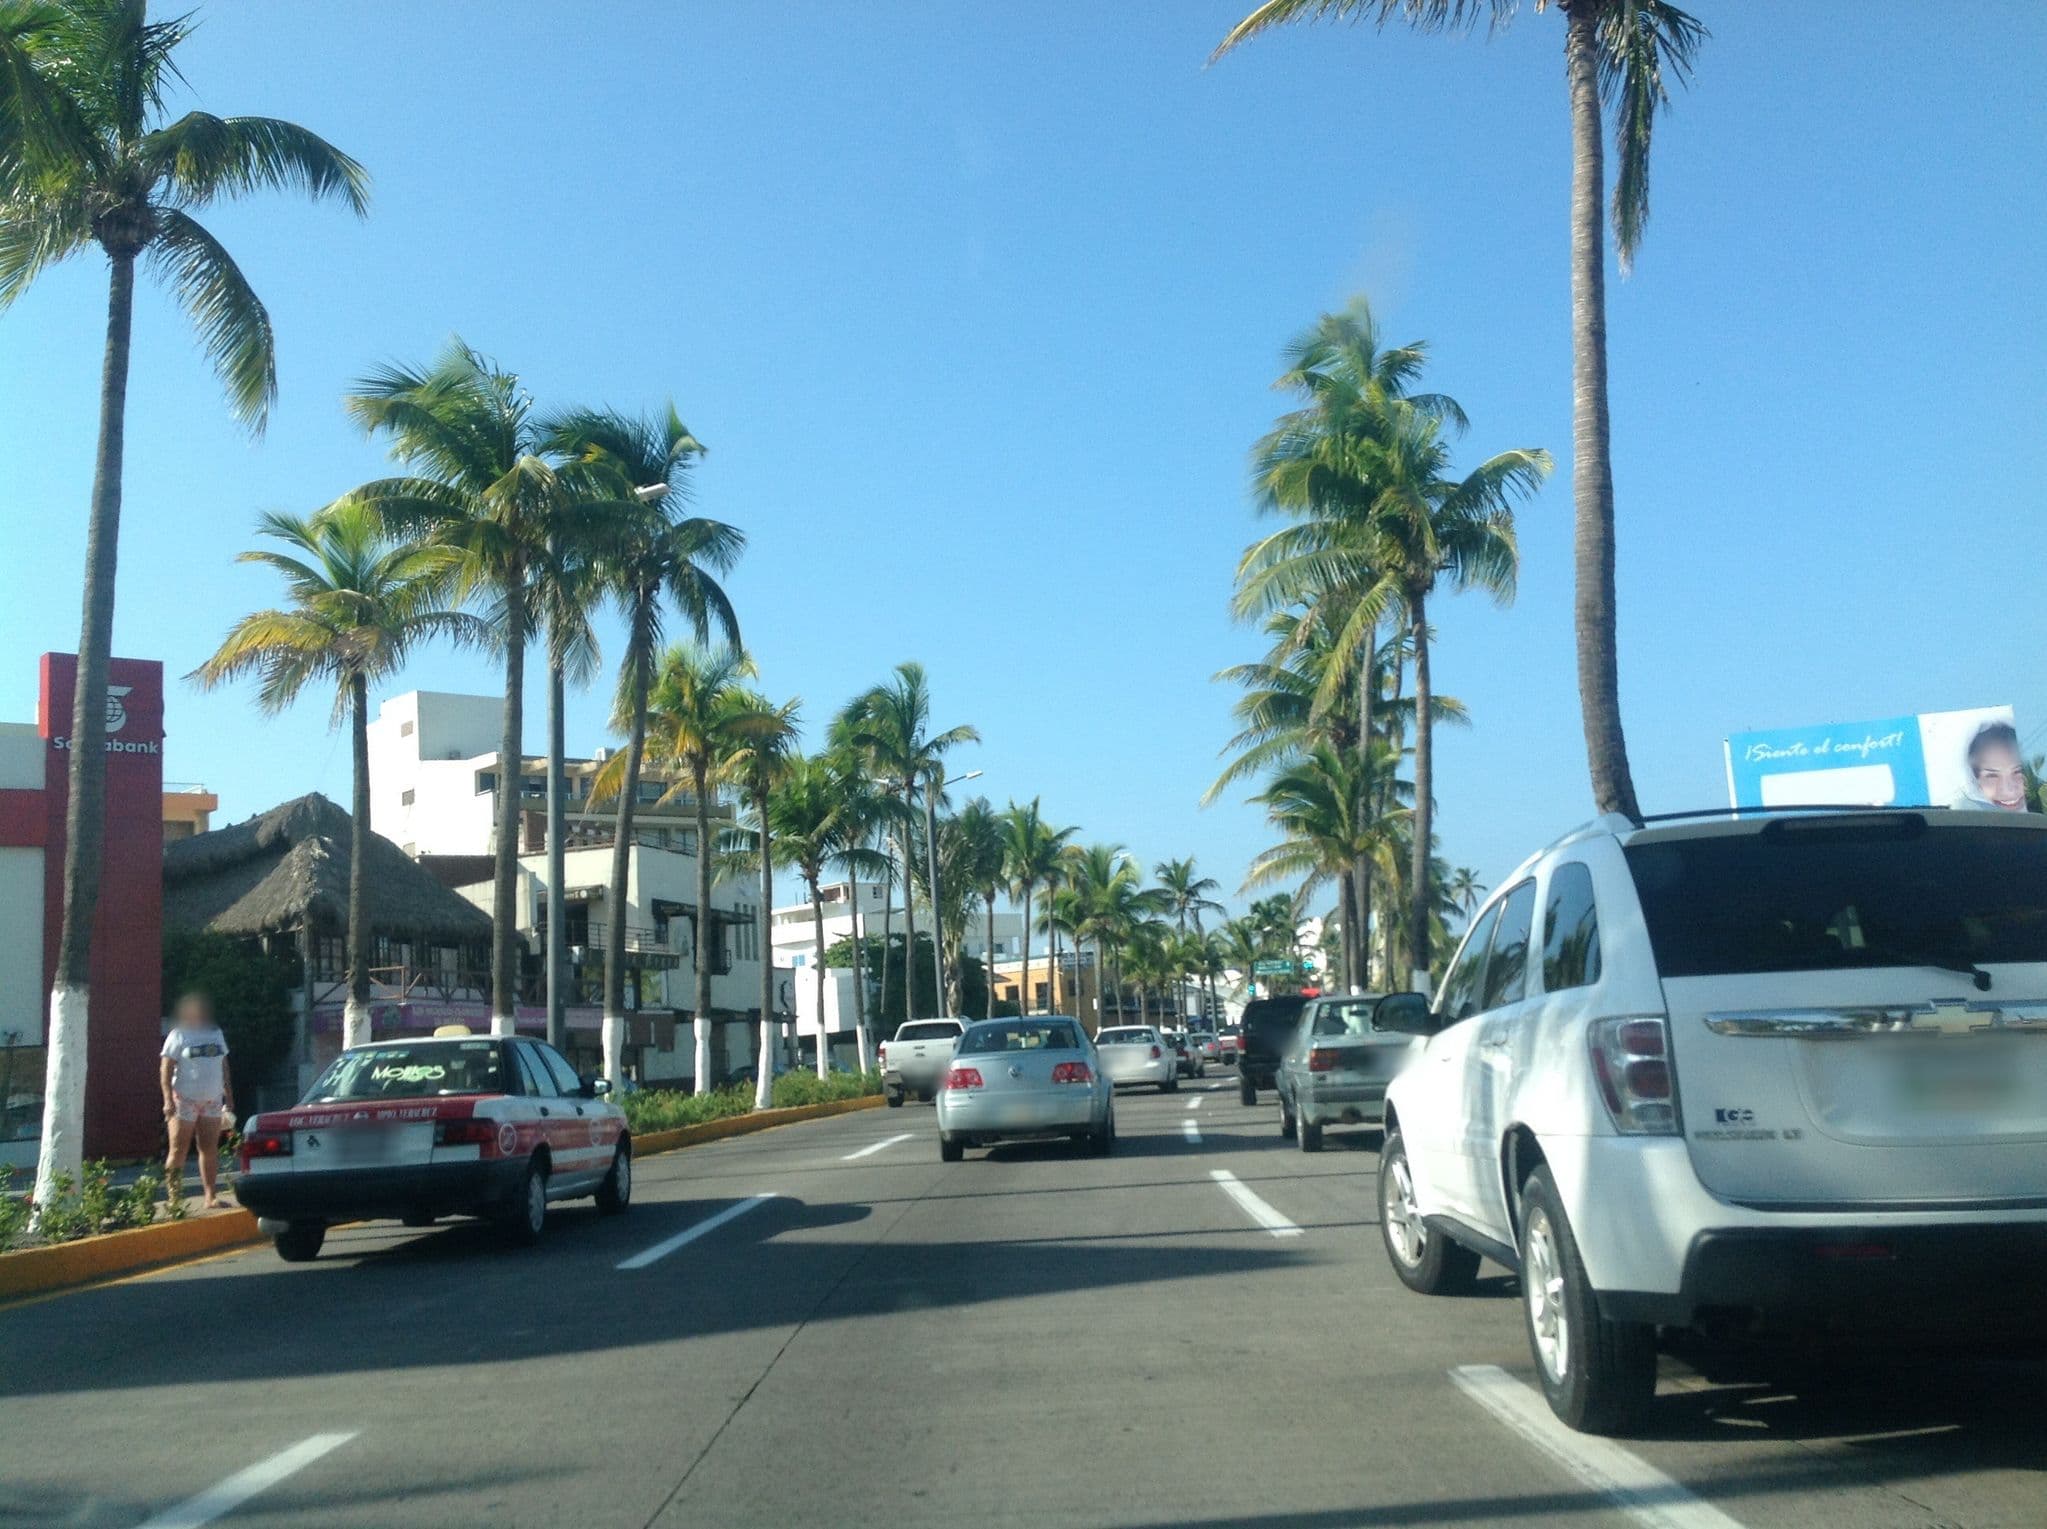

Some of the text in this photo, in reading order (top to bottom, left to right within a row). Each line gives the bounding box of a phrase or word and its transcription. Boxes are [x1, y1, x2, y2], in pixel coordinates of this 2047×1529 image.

[53, 735, 159, 754] Scabank
[1813, 737, 1832, 753] el
[1834, 731, 1904, 759] confort!
